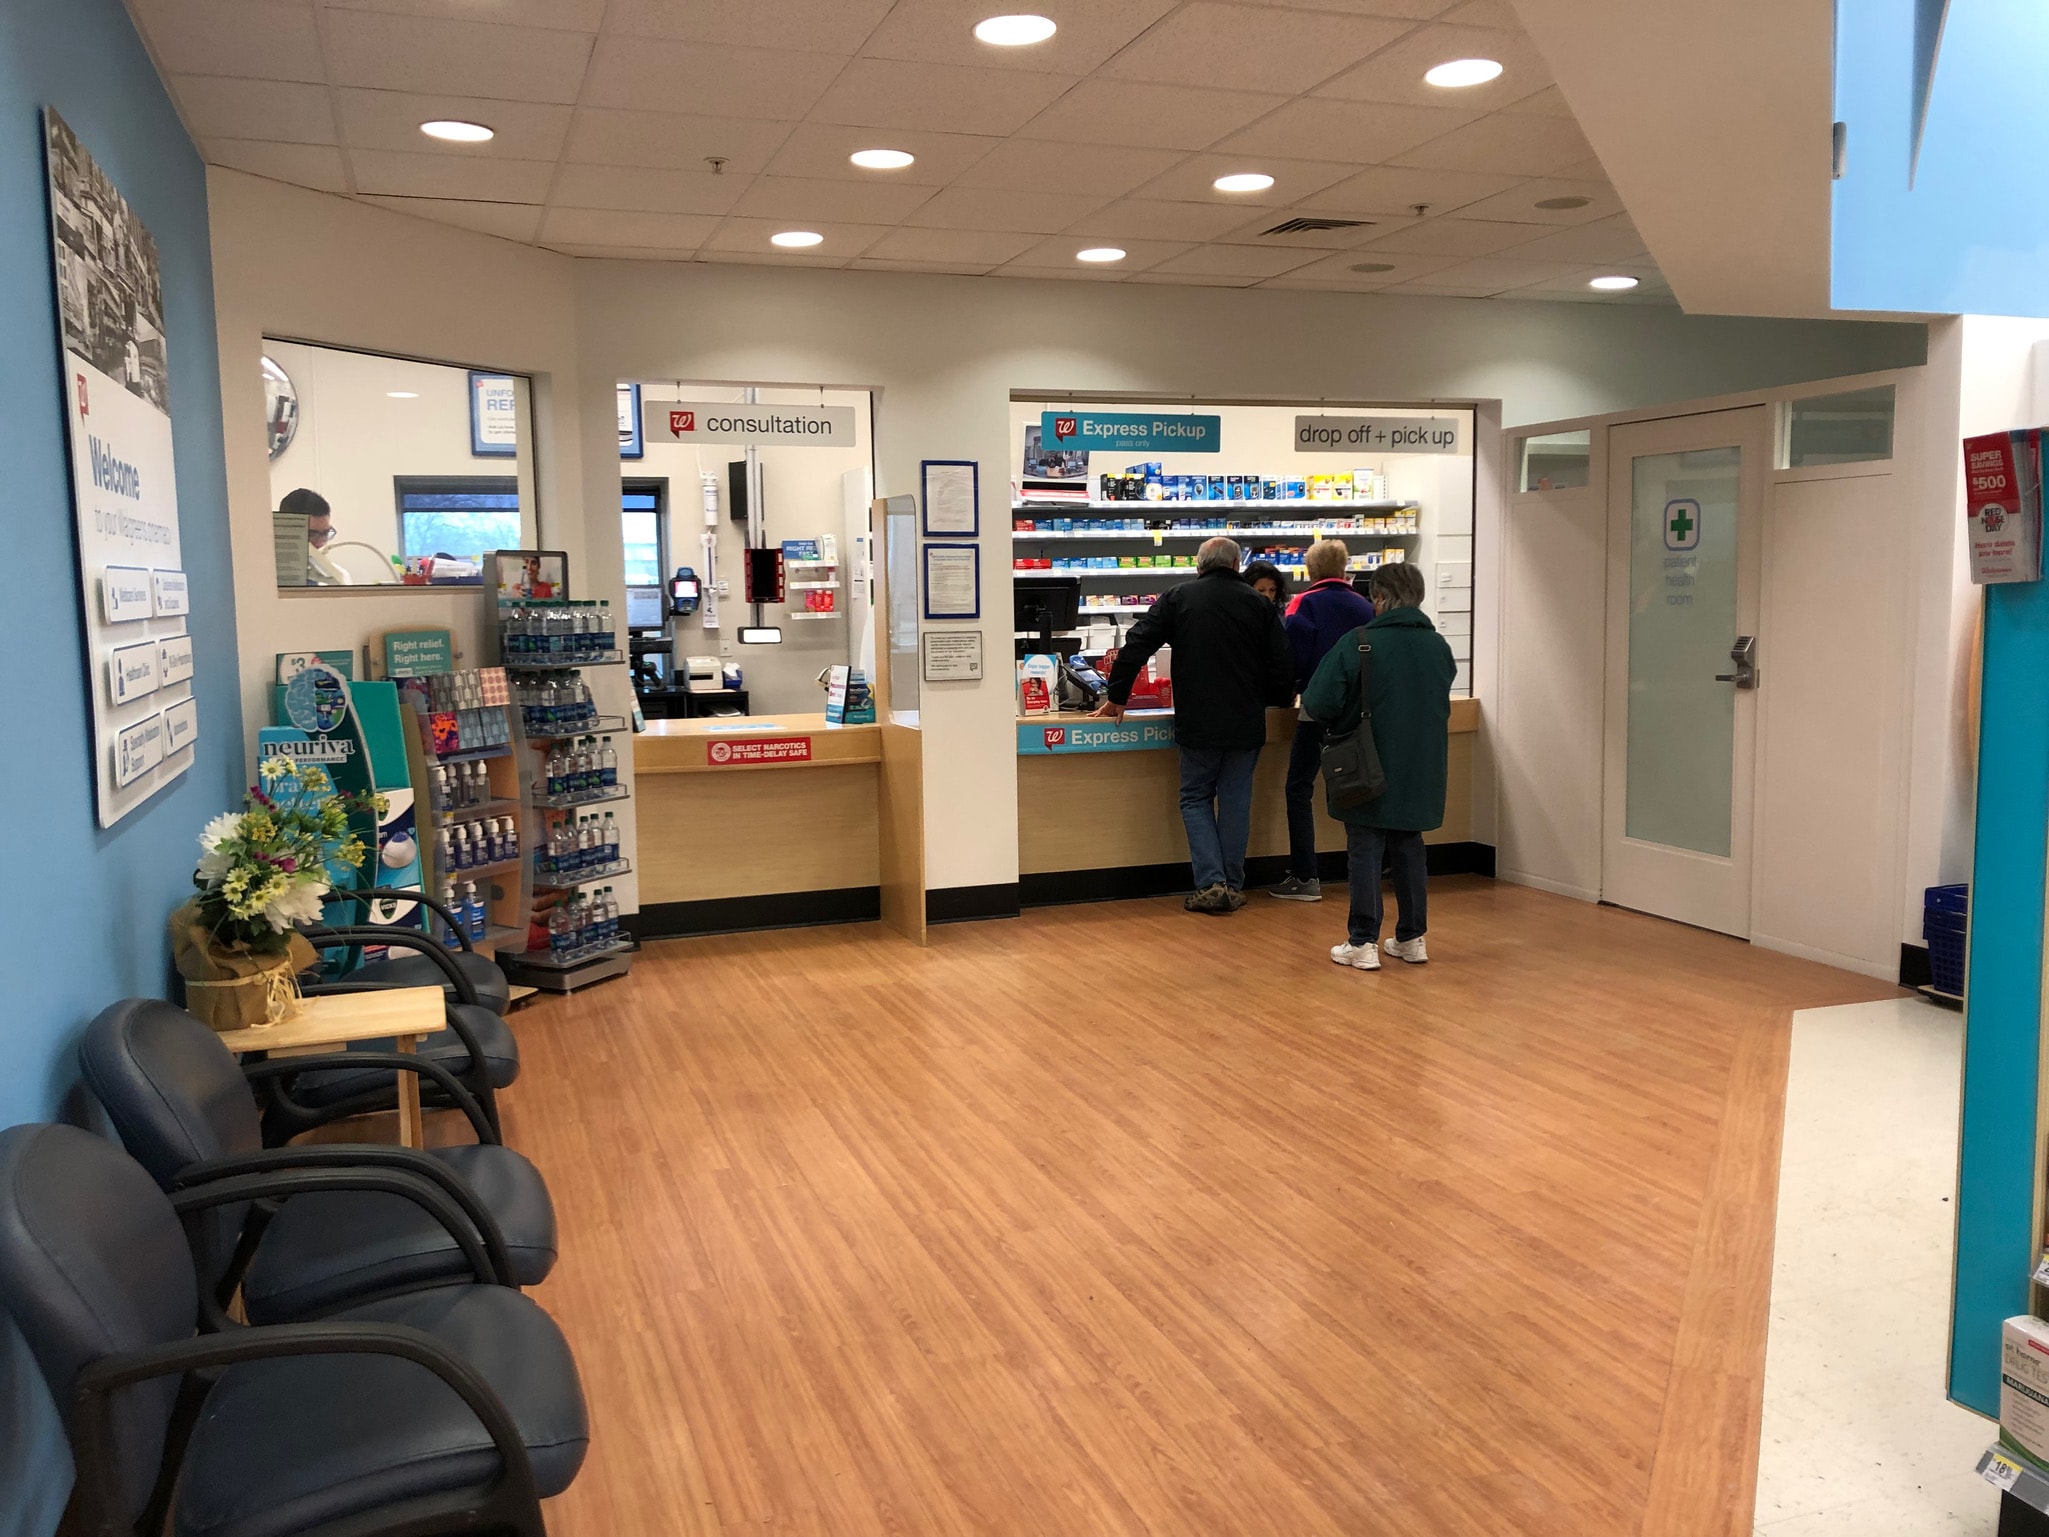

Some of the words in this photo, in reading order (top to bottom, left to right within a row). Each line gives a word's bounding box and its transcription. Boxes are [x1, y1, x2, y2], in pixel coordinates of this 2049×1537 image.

[707, 415, 832, 435] consultation
[1082, 420, 1147, 439] Express
[1152, 421, 1206, 440] Pickup
[1300, 424, 1342, 447] drop
[1348, 425, 1372, 443] off
[1392, 426, 1428, 448] pick
[1432, 431, 1454, 449] up
[1970, 450, 2002, 462] SUPER
[88, 433, 140, 501] Welcome
[1973, 475, 2006, 490] $500
[1985, 508, 2002, 516] RED
[1986, 523, 2002, 533] DAY
[1664, 555, 1697, 571] patient
[1665, 573, 1695, 587] health
[1667, 594, 1693, 606] room
[393, 641, 417, 652] Right
[420, 639, 444, 649] relief.
[394, 654, 418, 665] Right
[421, 653, 443, 661] here.
[262, 734, 354, 756] neuriva
[1071, 729, 1139, 747] Express
[732, 744, 762, 752] SELECT
[763, 742, 806, 750] NARCOTICS
[742, 750, 788, 759] TIME-DELAY
[788, 749, 808, 757] SAFE
[2005, 1353, 2029, 1375] DRUG
[2016, 1346, 2041, 1367] home
